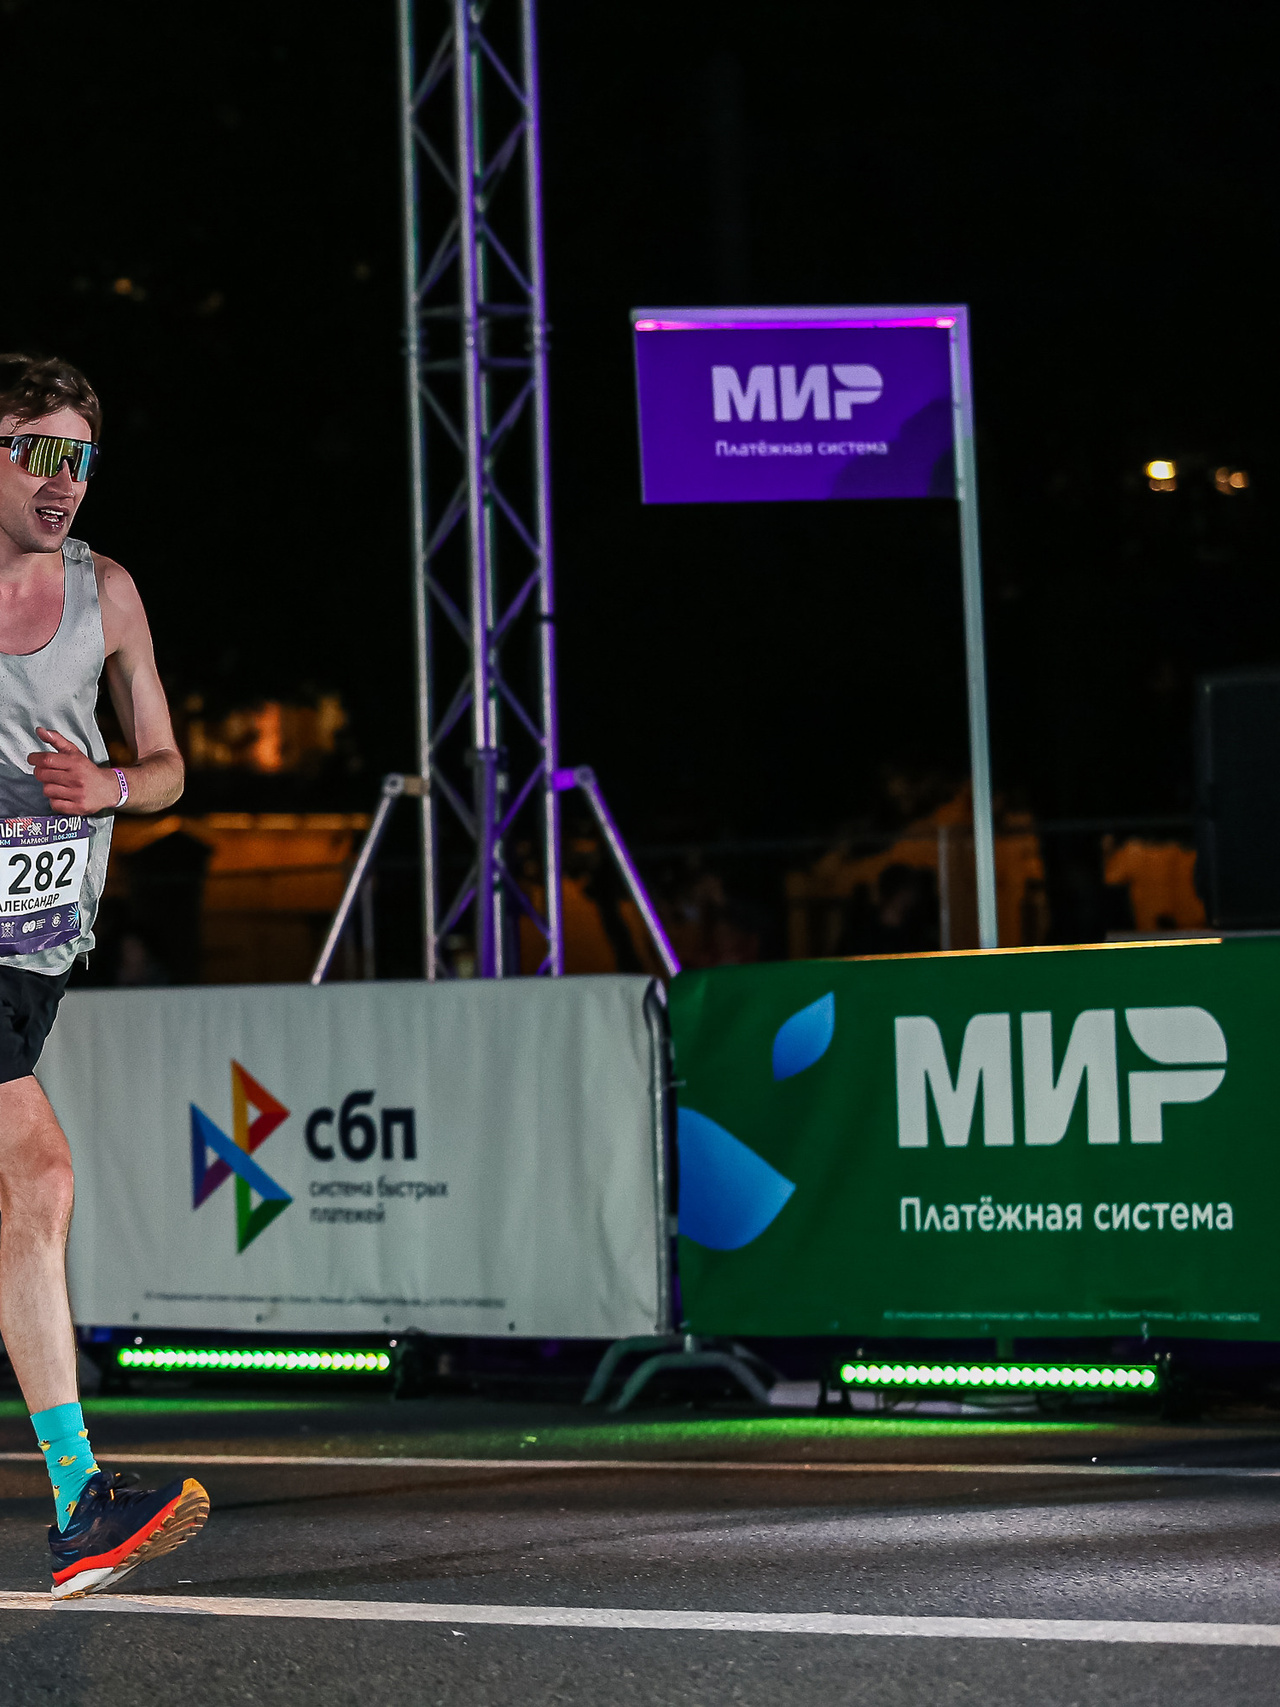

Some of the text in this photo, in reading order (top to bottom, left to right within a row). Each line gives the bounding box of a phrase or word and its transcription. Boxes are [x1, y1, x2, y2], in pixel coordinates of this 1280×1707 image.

[712, 364, 883, 422] МИР
[715, 440, 888, 456] Платёжная система
[46, 816, 82, 835] НОЧИ
[894, 1006, 1228, 1148] МИР
[304, 1090, 417, 1162] сбп
[310, 1175, 447, 1201] система быстрых
[310, 1202, 386, 1223] платежей
[900, 1196, 1234, 1233] Платёжная система
